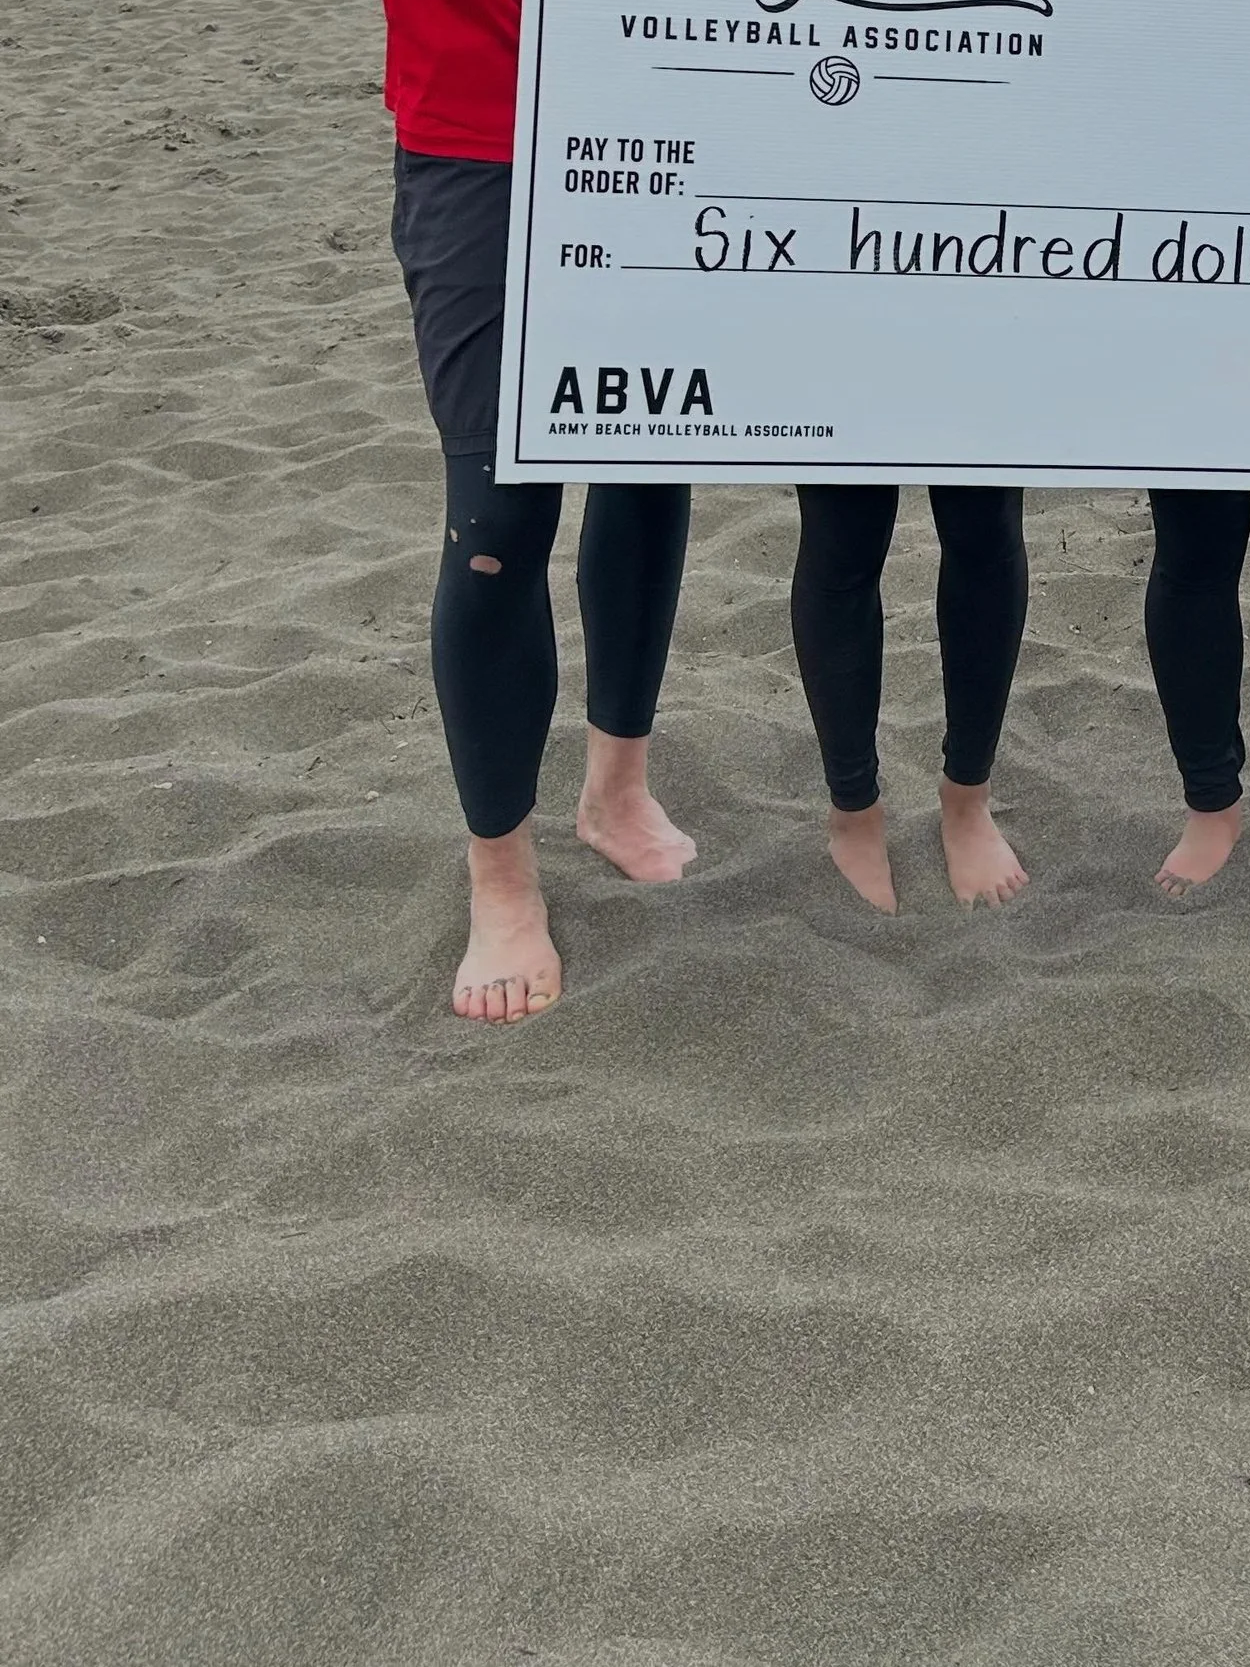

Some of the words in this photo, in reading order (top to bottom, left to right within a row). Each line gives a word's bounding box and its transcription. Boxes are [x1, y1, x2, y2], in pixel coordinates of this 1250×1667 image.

[620, 14, 821, 47] VOLLEYBALL
[842, 25, 1044, 57] ASSOCIATION
[566, 136, 609, 161] PAY
[617, 138, 644, 163] TO
[653, 139, 696, 164] THE
[564, 168, 640, 194] ORDER
[649, 171, 684, 196] OF:
[560, 243, 612, 269] FOR:
[694, 206, 797, 272] Six
[850, 207, 1124, 280] hundred
[550, 366, 714, 416] ABVA
[548, 422, 589, 436] ARMY
[595, 423, 641, 437] BEACH
[647, 424, 738, 437] VOLLEYBALL
[744, 425, 834, 438] ASSOCIATION
